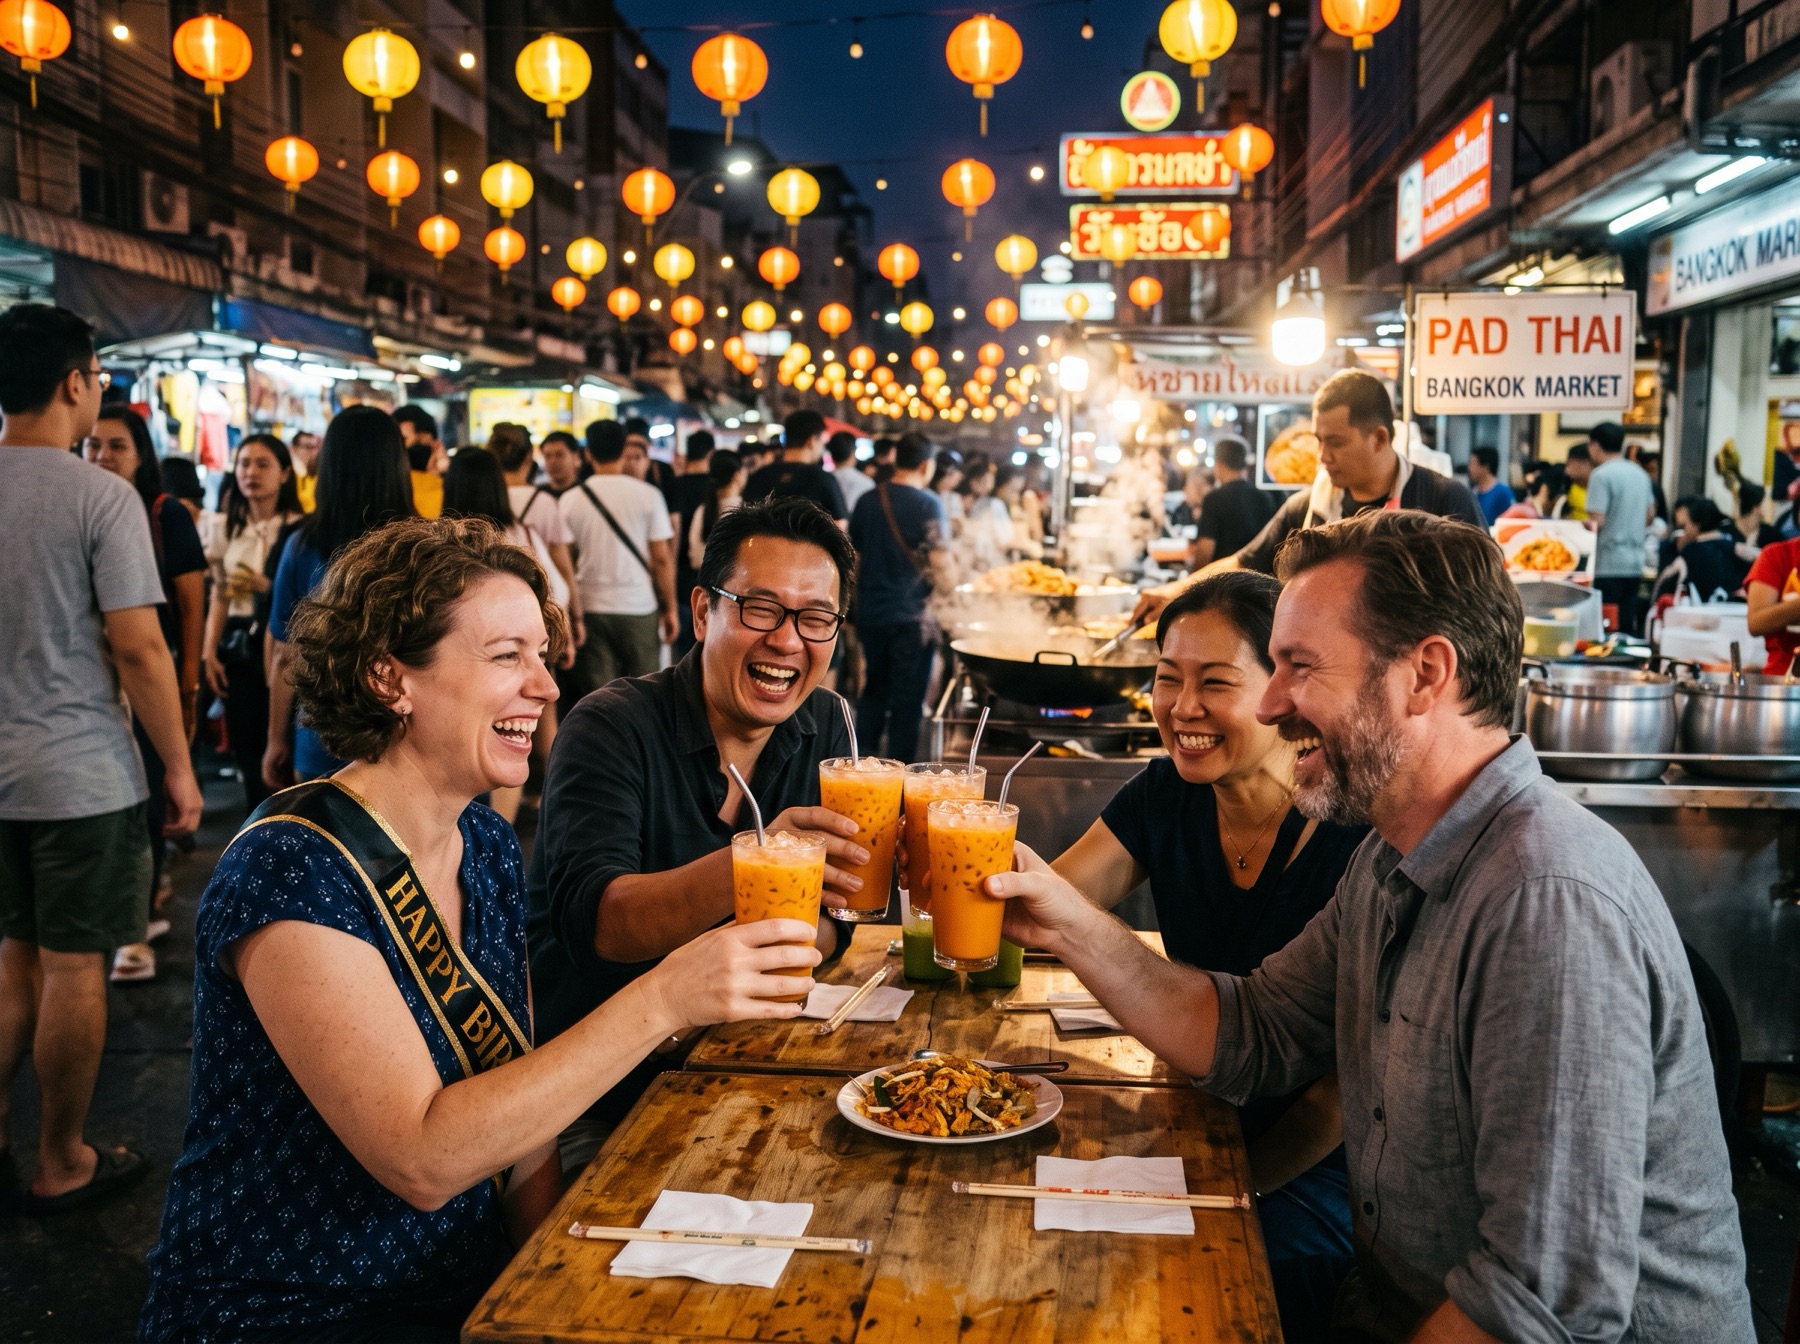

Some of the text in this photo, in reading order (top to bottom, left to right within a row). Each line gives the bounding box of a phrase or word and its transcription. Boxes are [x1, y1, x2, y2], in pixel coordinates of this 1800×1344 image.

[1676, 217, 1800, 291] BANGKOK MAR
[1428, 315, 1622, 355] PAD THAI
[1427, 375, 1622, 398] BANGKOK MARKET
[385, 871, 473, 1006] HAPPY
